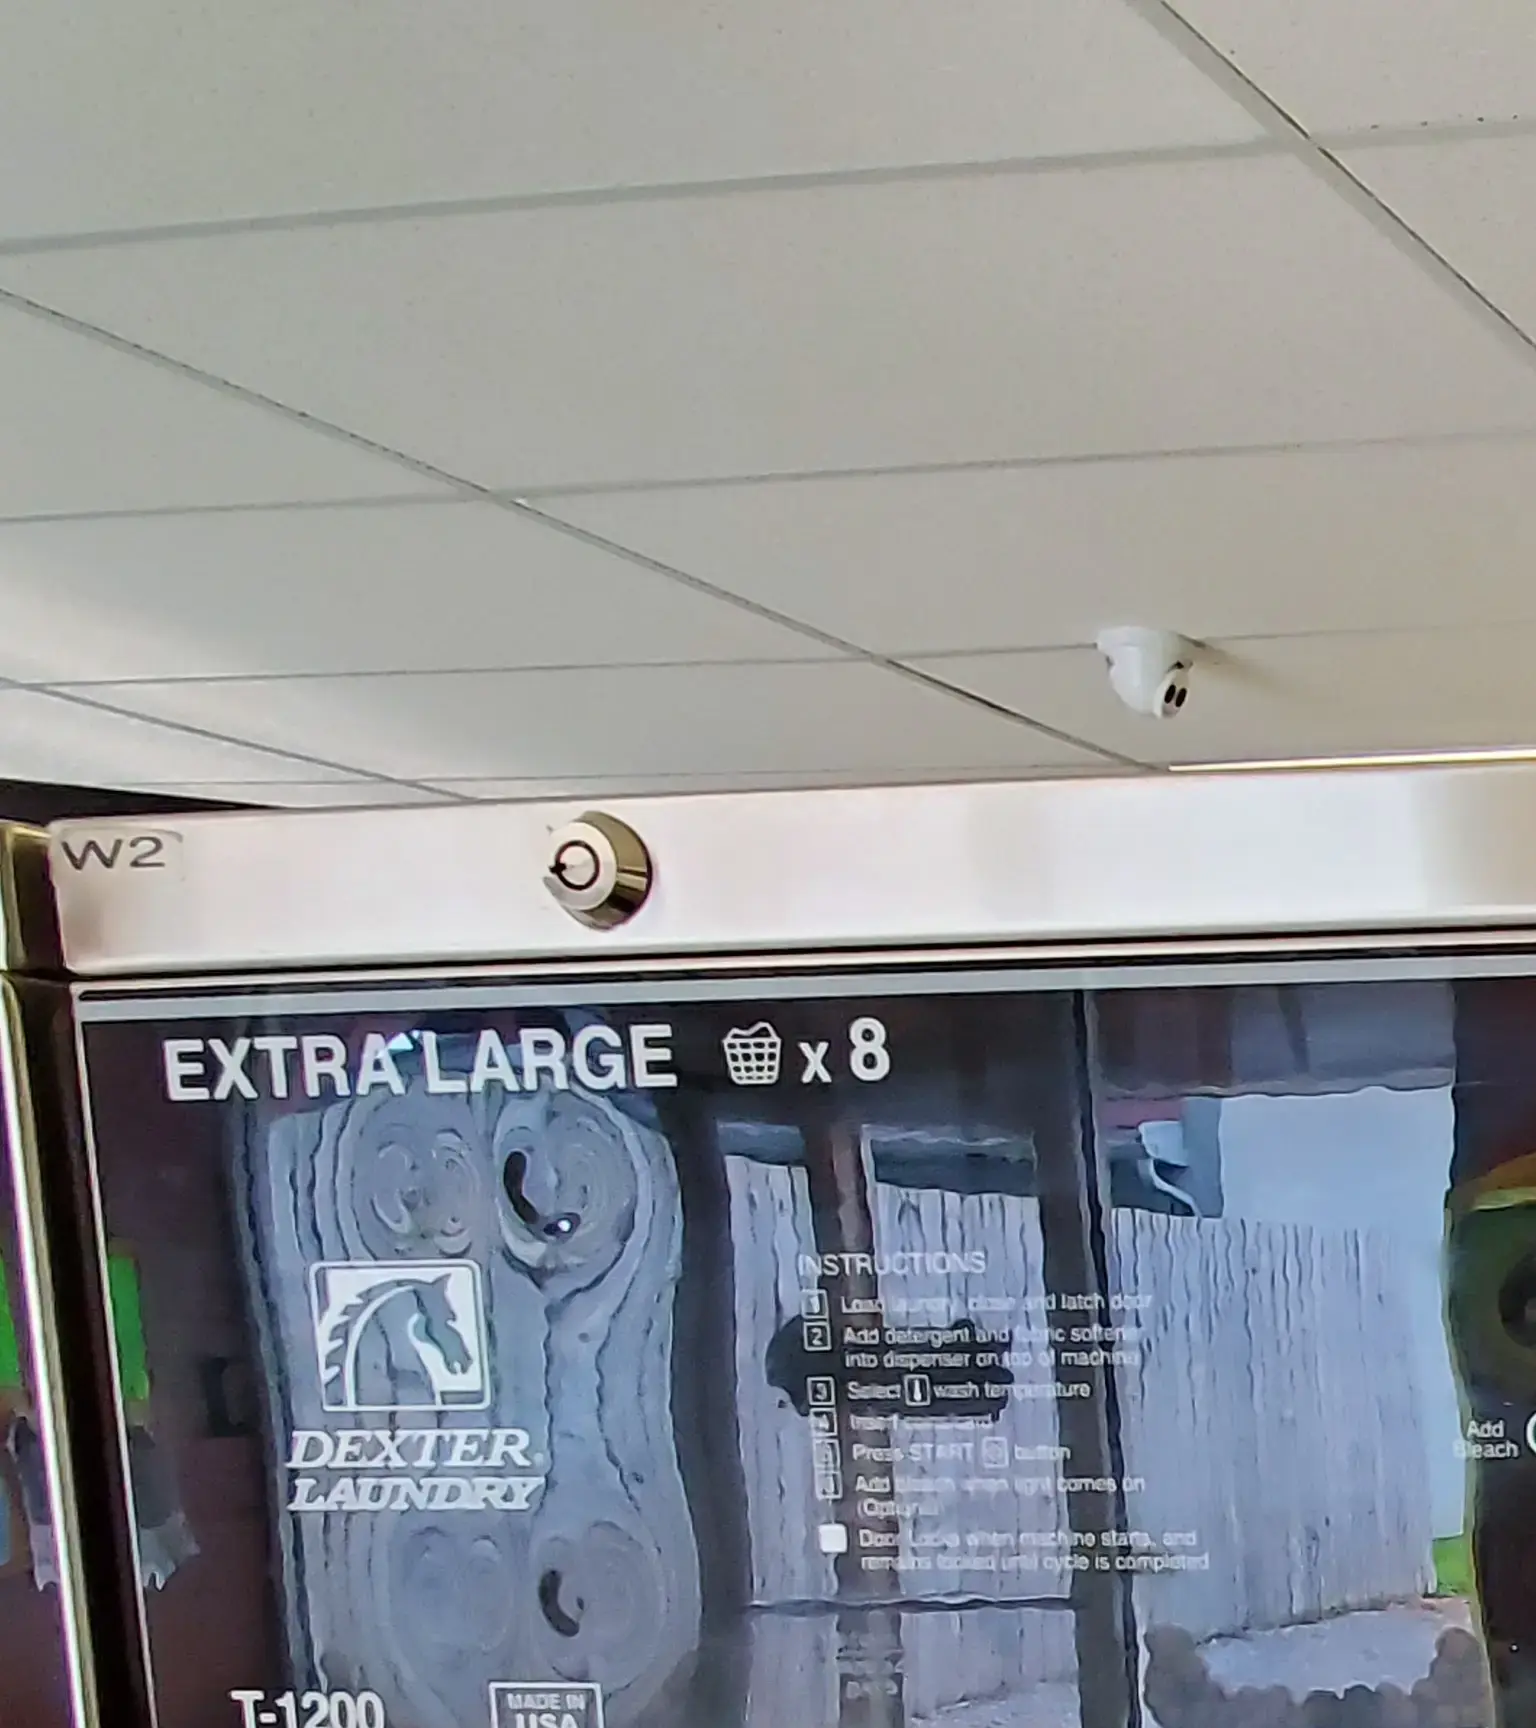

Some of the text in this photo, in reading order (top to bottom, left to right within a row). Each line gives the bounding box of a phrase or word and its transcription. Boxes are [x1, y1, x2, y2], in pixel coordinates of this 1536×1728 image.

[62, 835, 167, 872] W2
[162, 1033, 406, 1102] EXTRA
[424, 1023, 678, 1094] LARGE
[850, 1016, 891, 1081] 8
[799, 1250, 988, 1276] INSTRUCTIONS
[1061, 1292, 1106, 1311] latch
[843, 1326, 880, 1346] Add
[885, 1326, 971, 1349] detergent
[975, 1325, 1011, 1345] and
[845, 1351, 879, 1369] into
[883, 1350, 972, 1372] dispenser
[976, 1352, 999, 1368] on
[933, 1381, 980, 1399] wash
[1466, 1420, 1504, 1439] Add
[285, 1428, 531, 1470] DEXTER
[1453, 1439, 1519, 1460] Bleach
[286, 1476, 547, 1511] LAUNDRY
[507, 1693, 586, 1711] MADE IN
